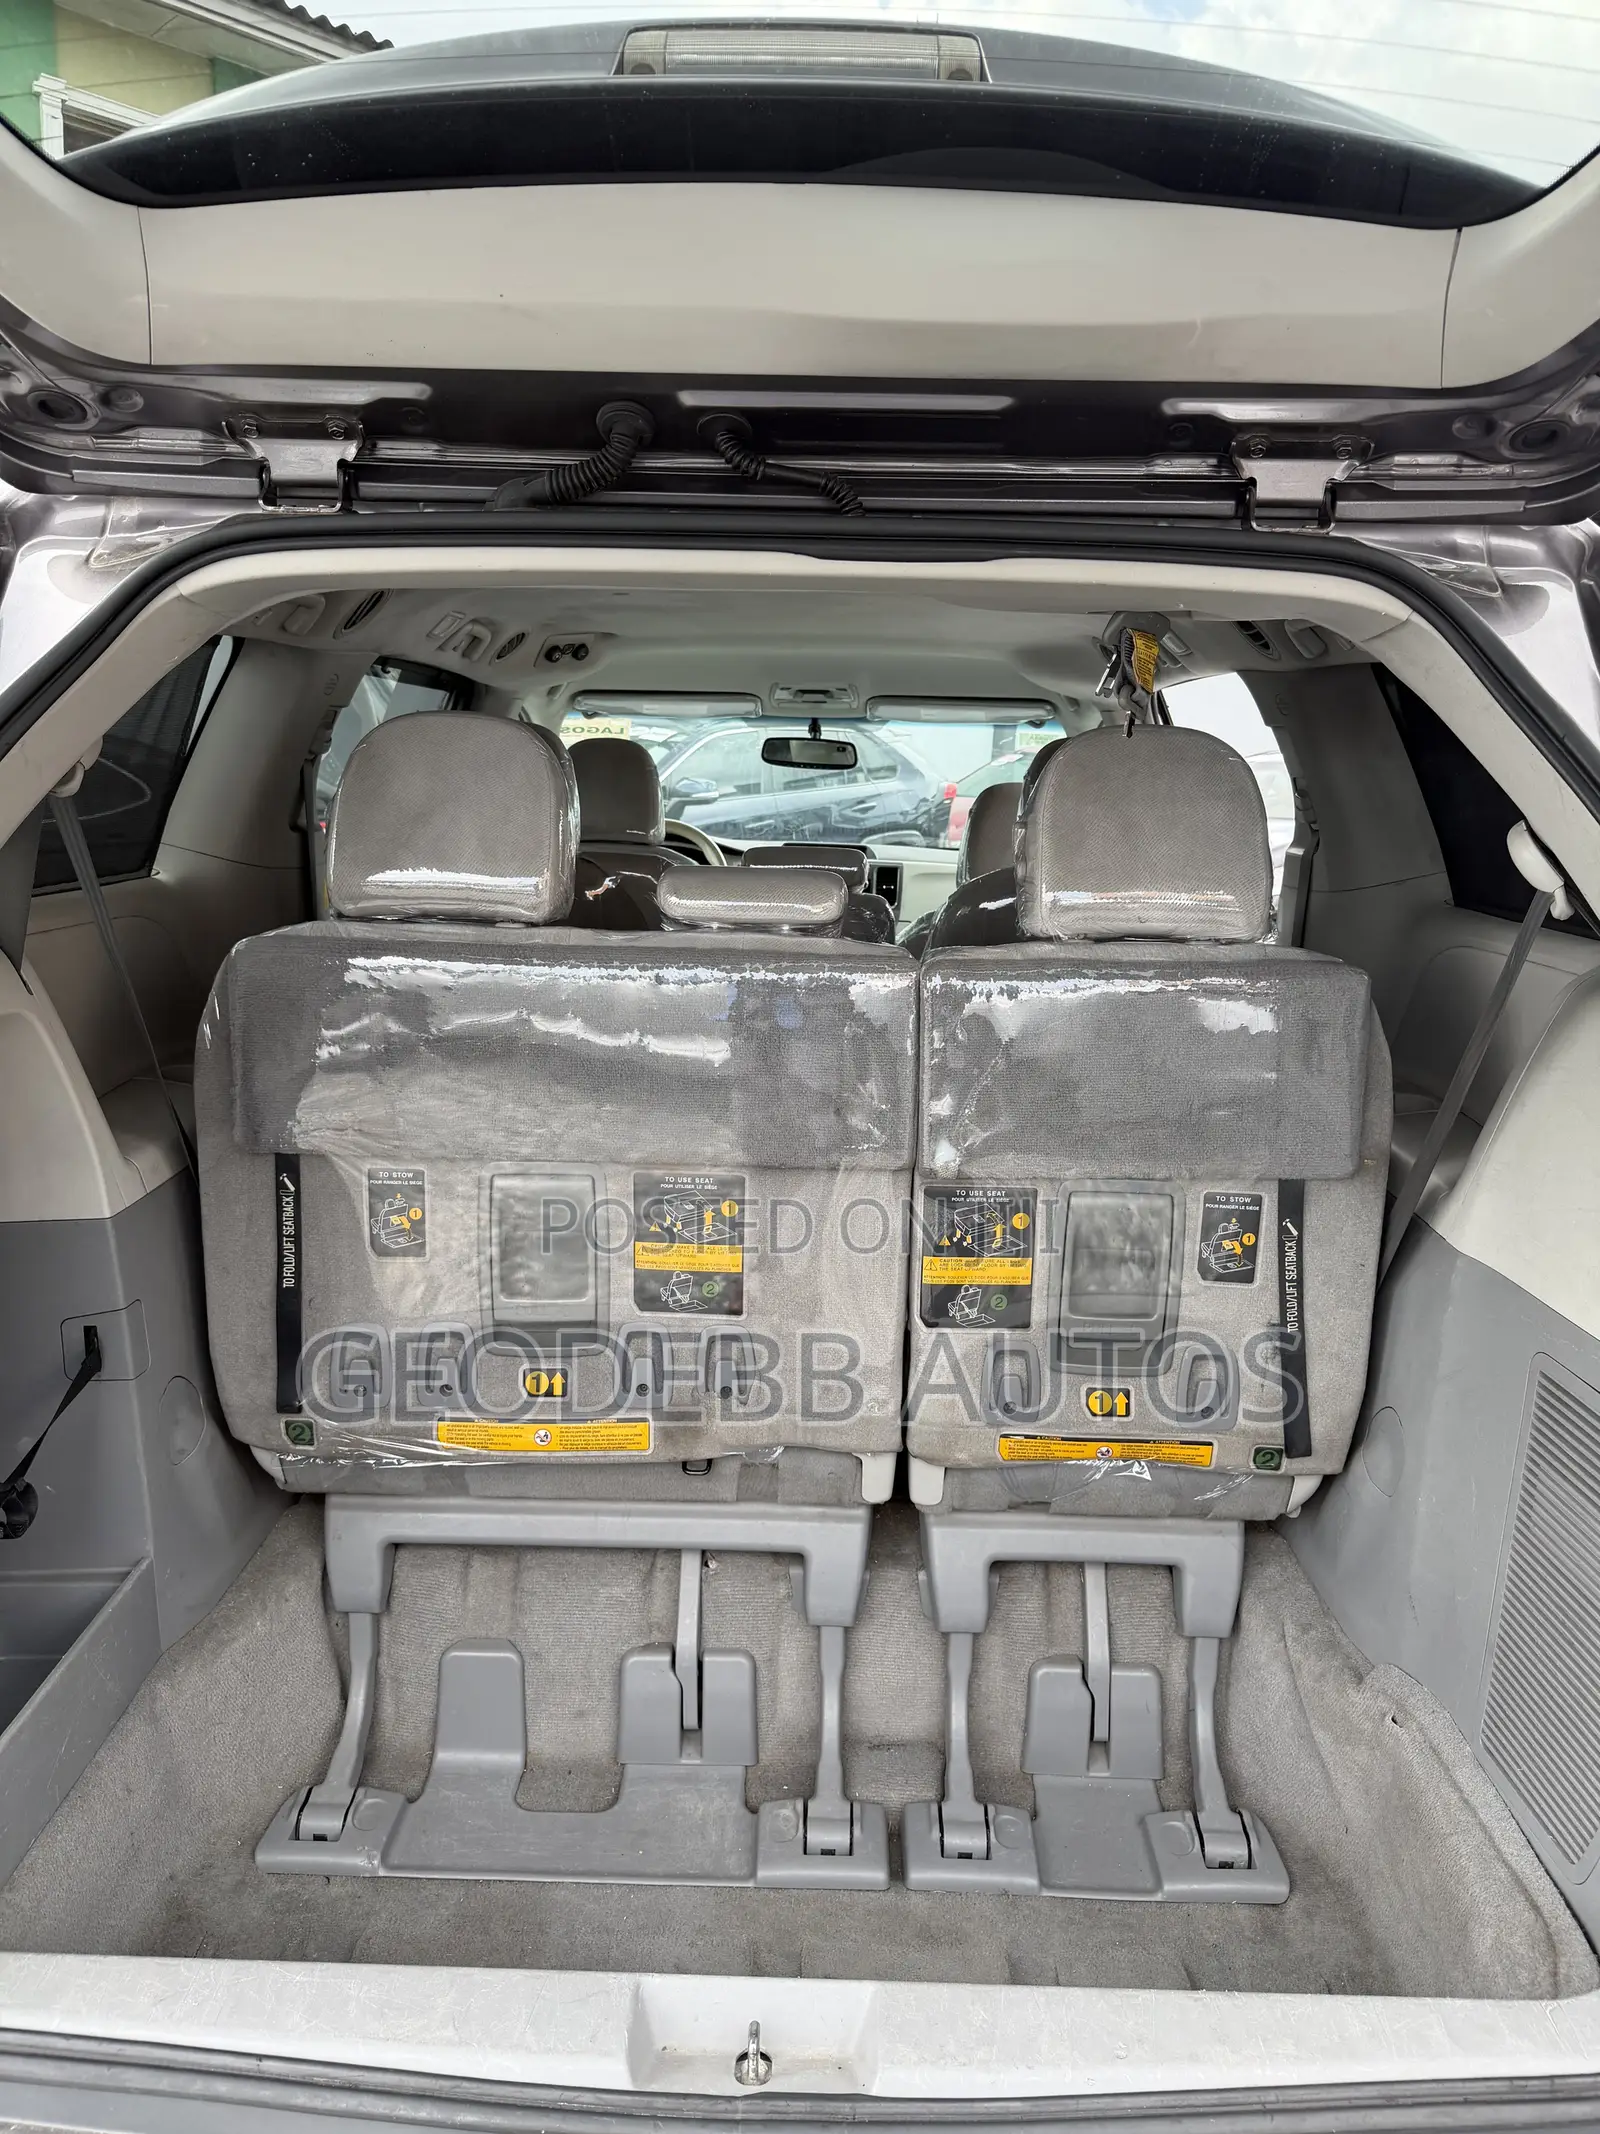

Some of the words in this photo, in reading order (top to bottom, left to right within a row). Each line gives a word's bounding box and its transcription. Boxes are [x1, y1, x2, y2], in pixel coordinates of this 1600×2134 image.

[282, 1196, 295, 1235] SEATBACK
[283, 1237, 296, 1277] FOLD/LIFT
[1284, 1241, 1297, 1280] SEATBACK
[282, 1278, 295, 1288] TO
[1286, 1282, 1298, 1321] FOLD/LIFT
[1287, 1322, 1299, 1333] TO
